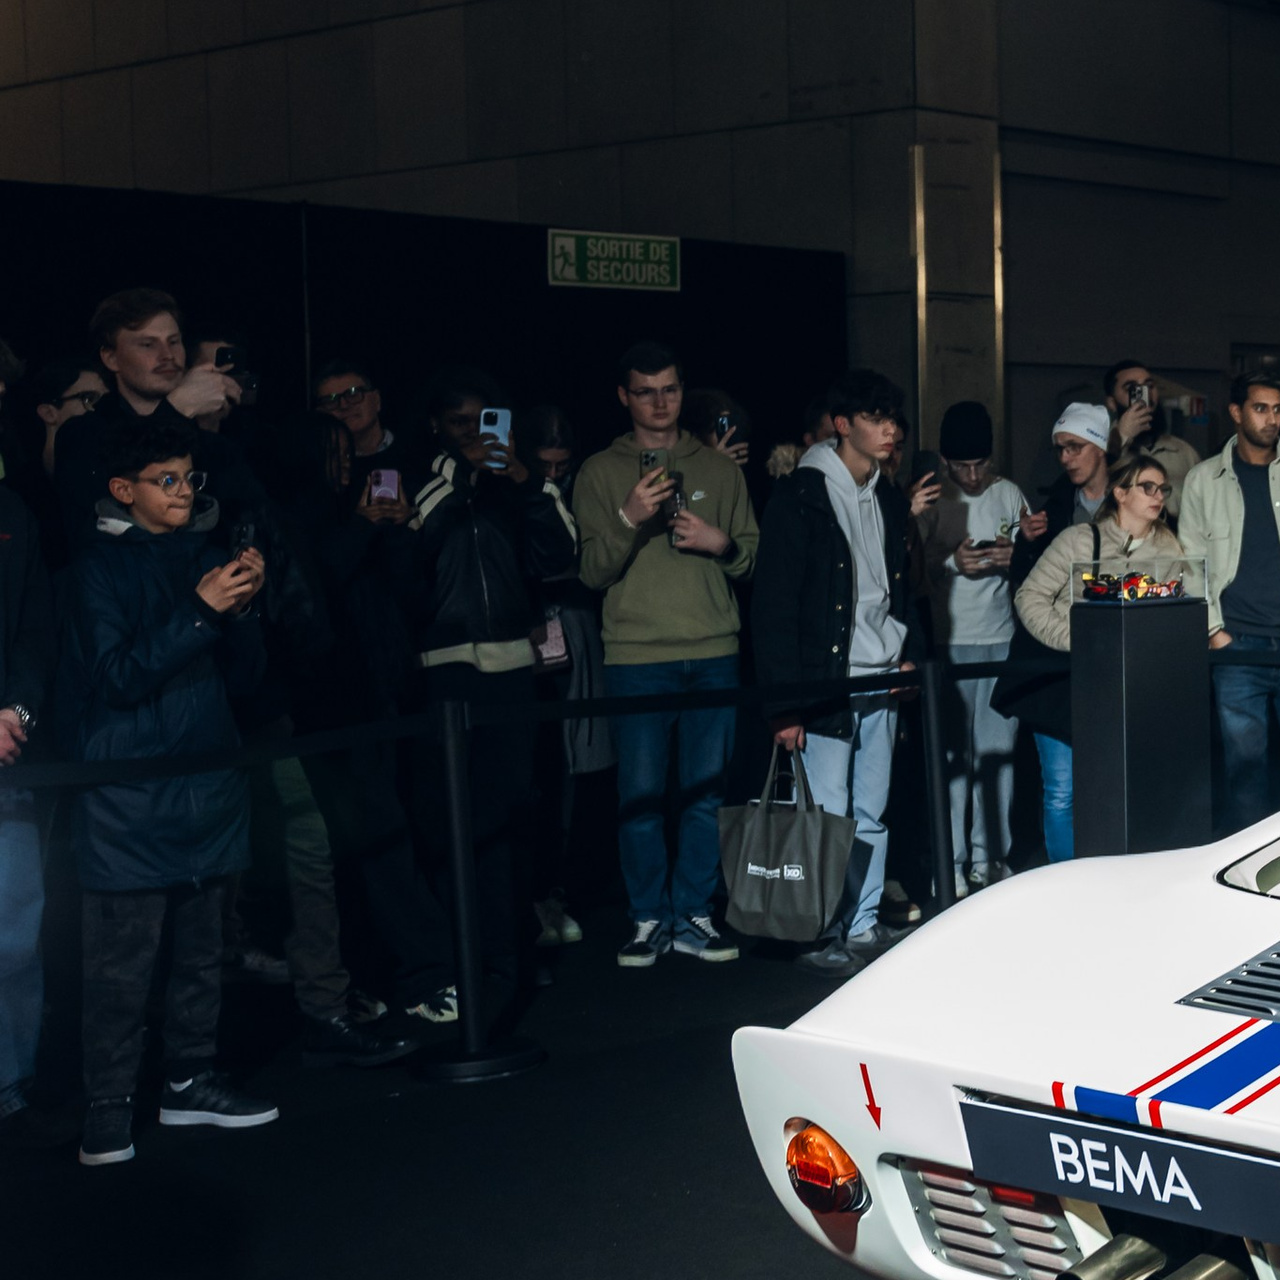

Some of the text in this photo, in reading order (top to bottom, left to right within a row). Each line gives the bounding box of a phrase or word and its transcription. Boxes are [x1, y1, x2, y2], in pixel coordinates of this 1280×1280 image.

[586, 238, 671, 261] SORTIE DE
[587, 261, 671, 285] SECOURS
[1049, 1132, 1203, 1211] BEMA
